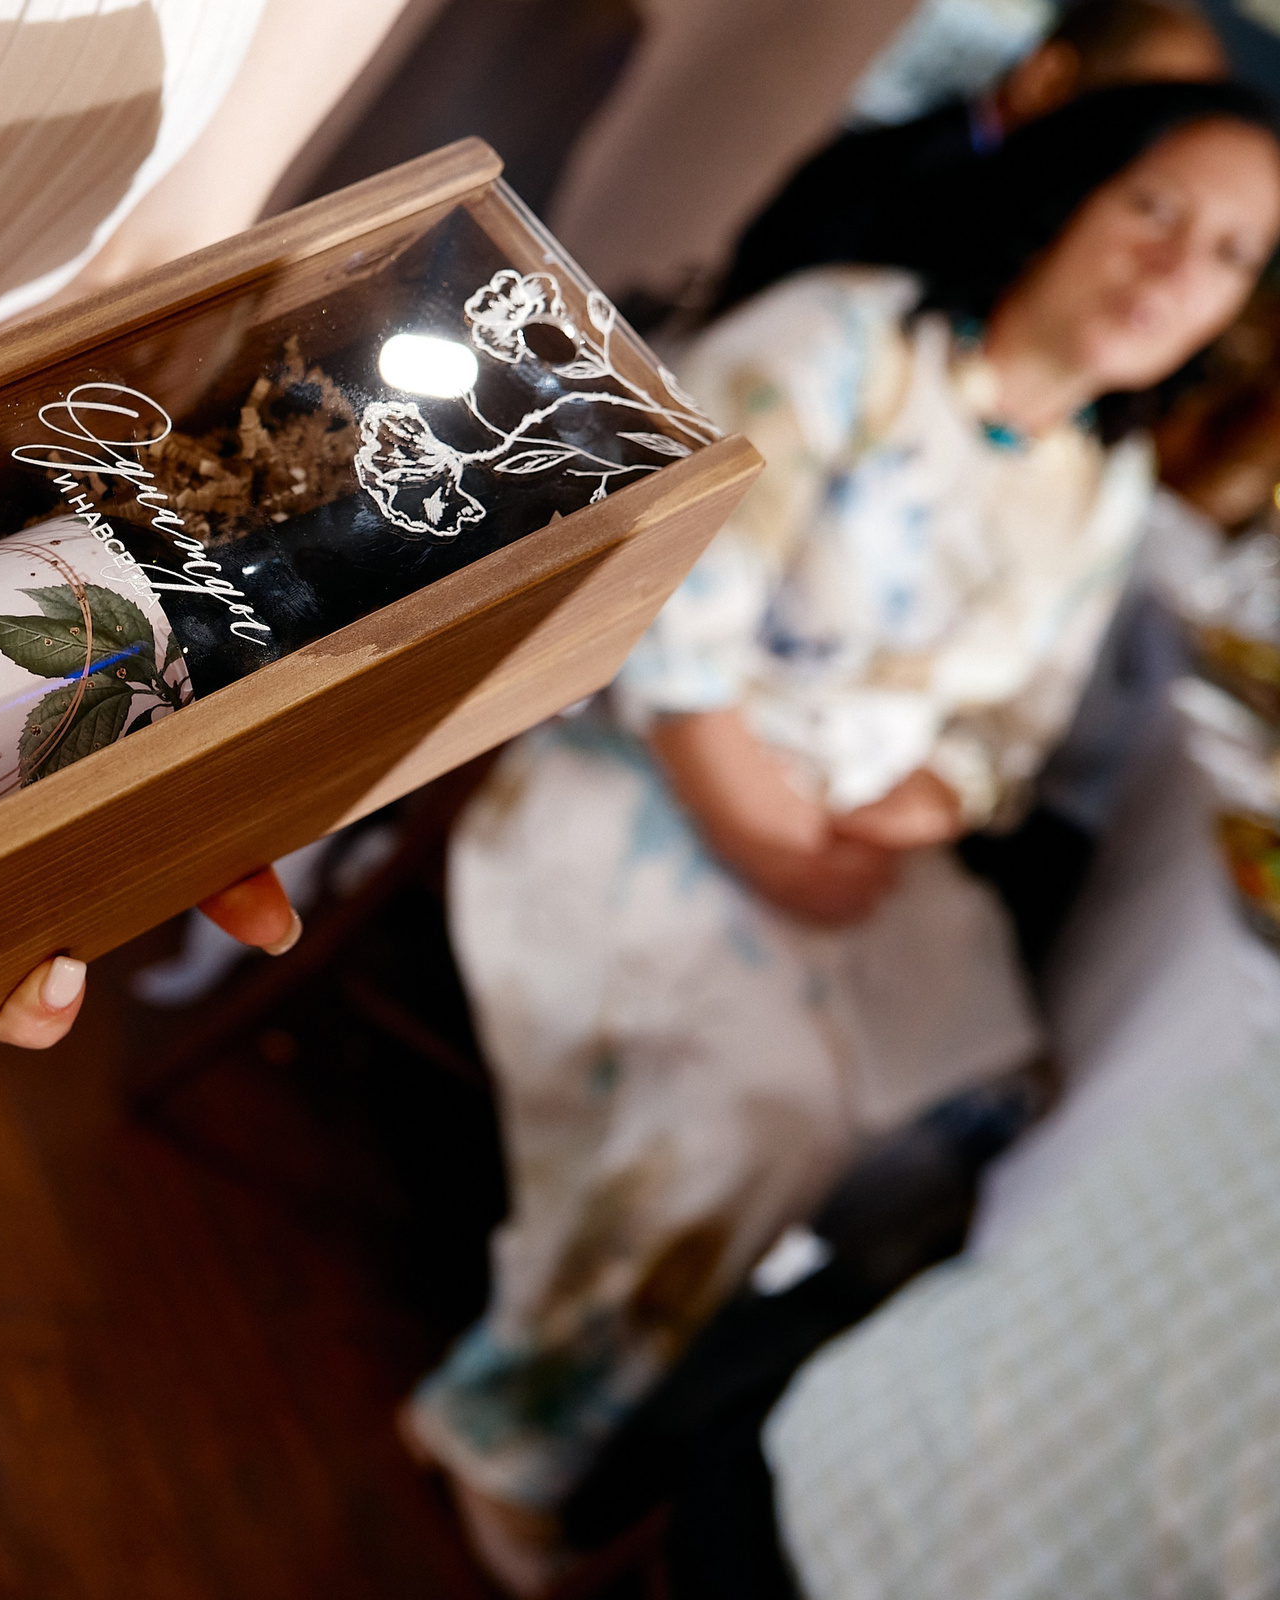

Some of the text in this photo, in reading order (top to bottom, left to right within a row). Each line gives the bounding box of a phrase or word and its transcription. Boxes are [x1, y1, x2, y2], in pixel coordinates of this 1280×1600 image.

[11, 382, 271, 646] Однажды
[52, 472, 162, 609] И НАВСЕГДА
